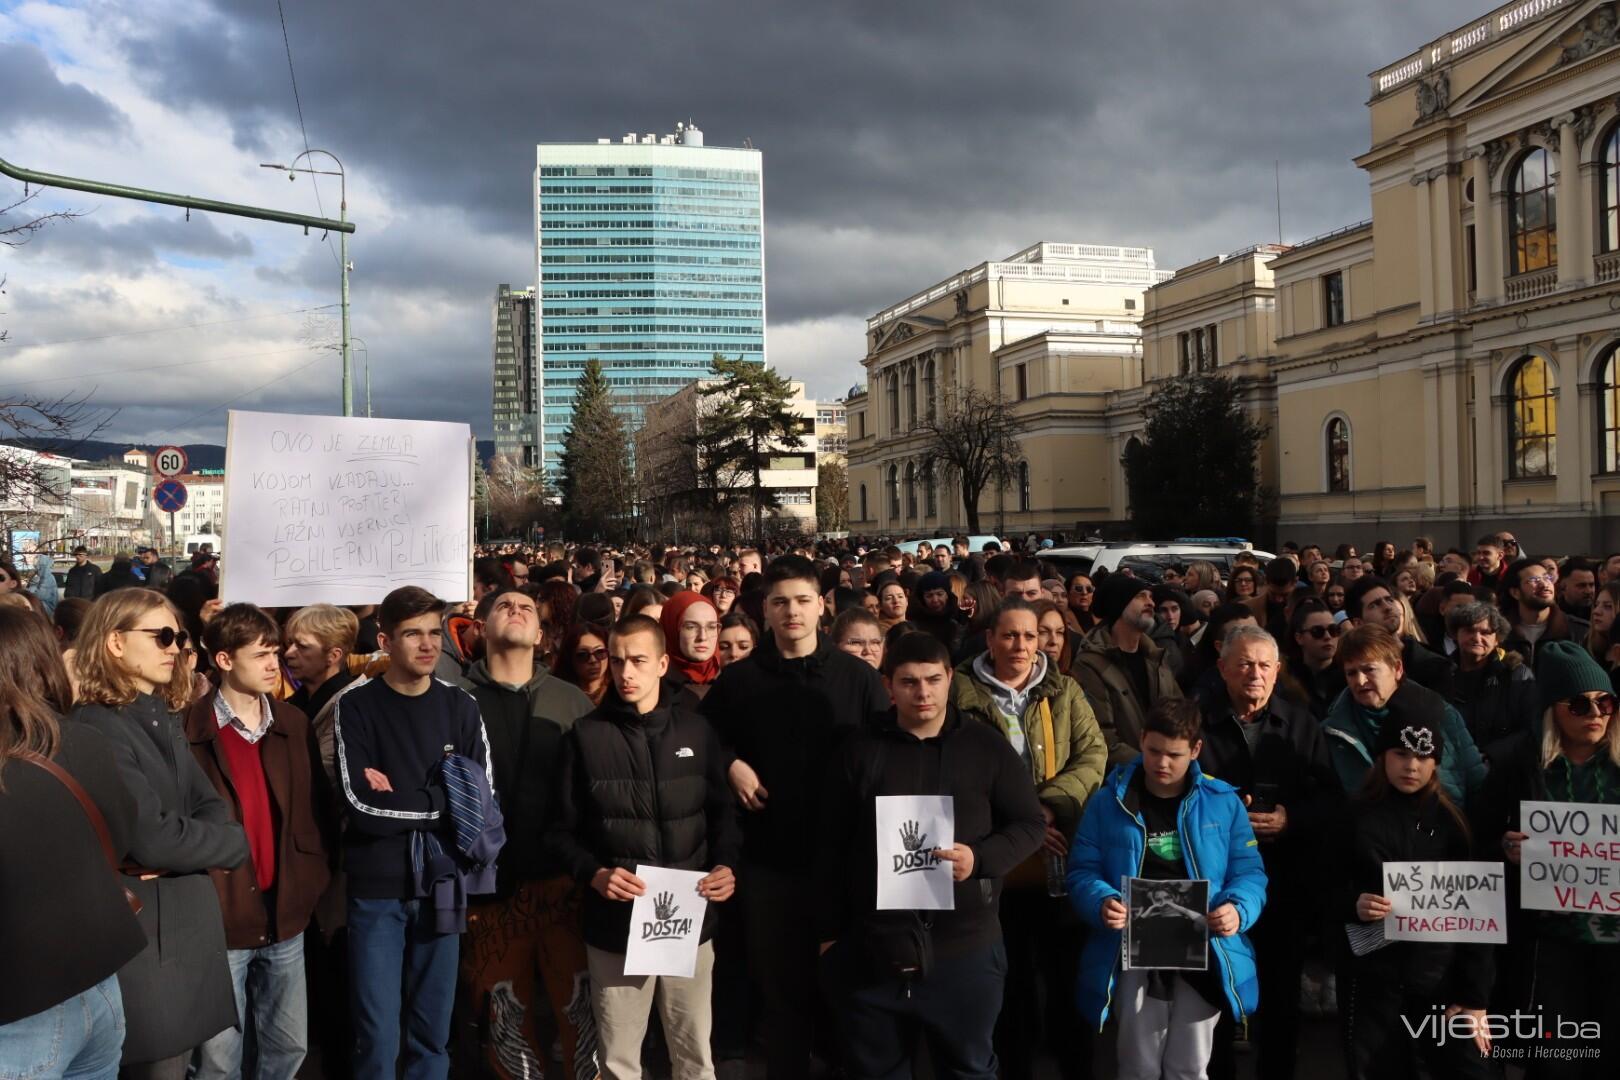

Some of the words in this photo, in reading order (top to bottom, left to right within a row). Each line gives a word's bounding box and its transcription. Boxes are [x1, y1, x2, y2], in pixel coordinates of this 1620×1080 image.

[271, 430, 313, 453] OVO
[323, 434, 343, 452] JE
[161, 454, 179, 470] 60
[253, 471, 312, 490] KOJOM
[328, 469, 414, 490] VLADAJU...
[272, 497, 330, 519] RATNI
[273, 521, 325, 544] LAŽNI
[1529, 810, 1590, 836] OVO
[1602, 814, 1618, 836] N
[1549, 841, 1620, 861] TRAGE
[1387, 865, 1424, 892] VAŠ
[1430, 873, 1503, 892] MANDAT
[1528, 861, 1579, 883] OVO
[1584, 867, 1611, 886] JE
[1411, 889, 1470, 910] NAŠA
[1554, 886, 1620, 911] VLAS
[641, 918, 692, 939] DOSTA!
[1395, 916, 1499, 932] TRAGEDIJA
